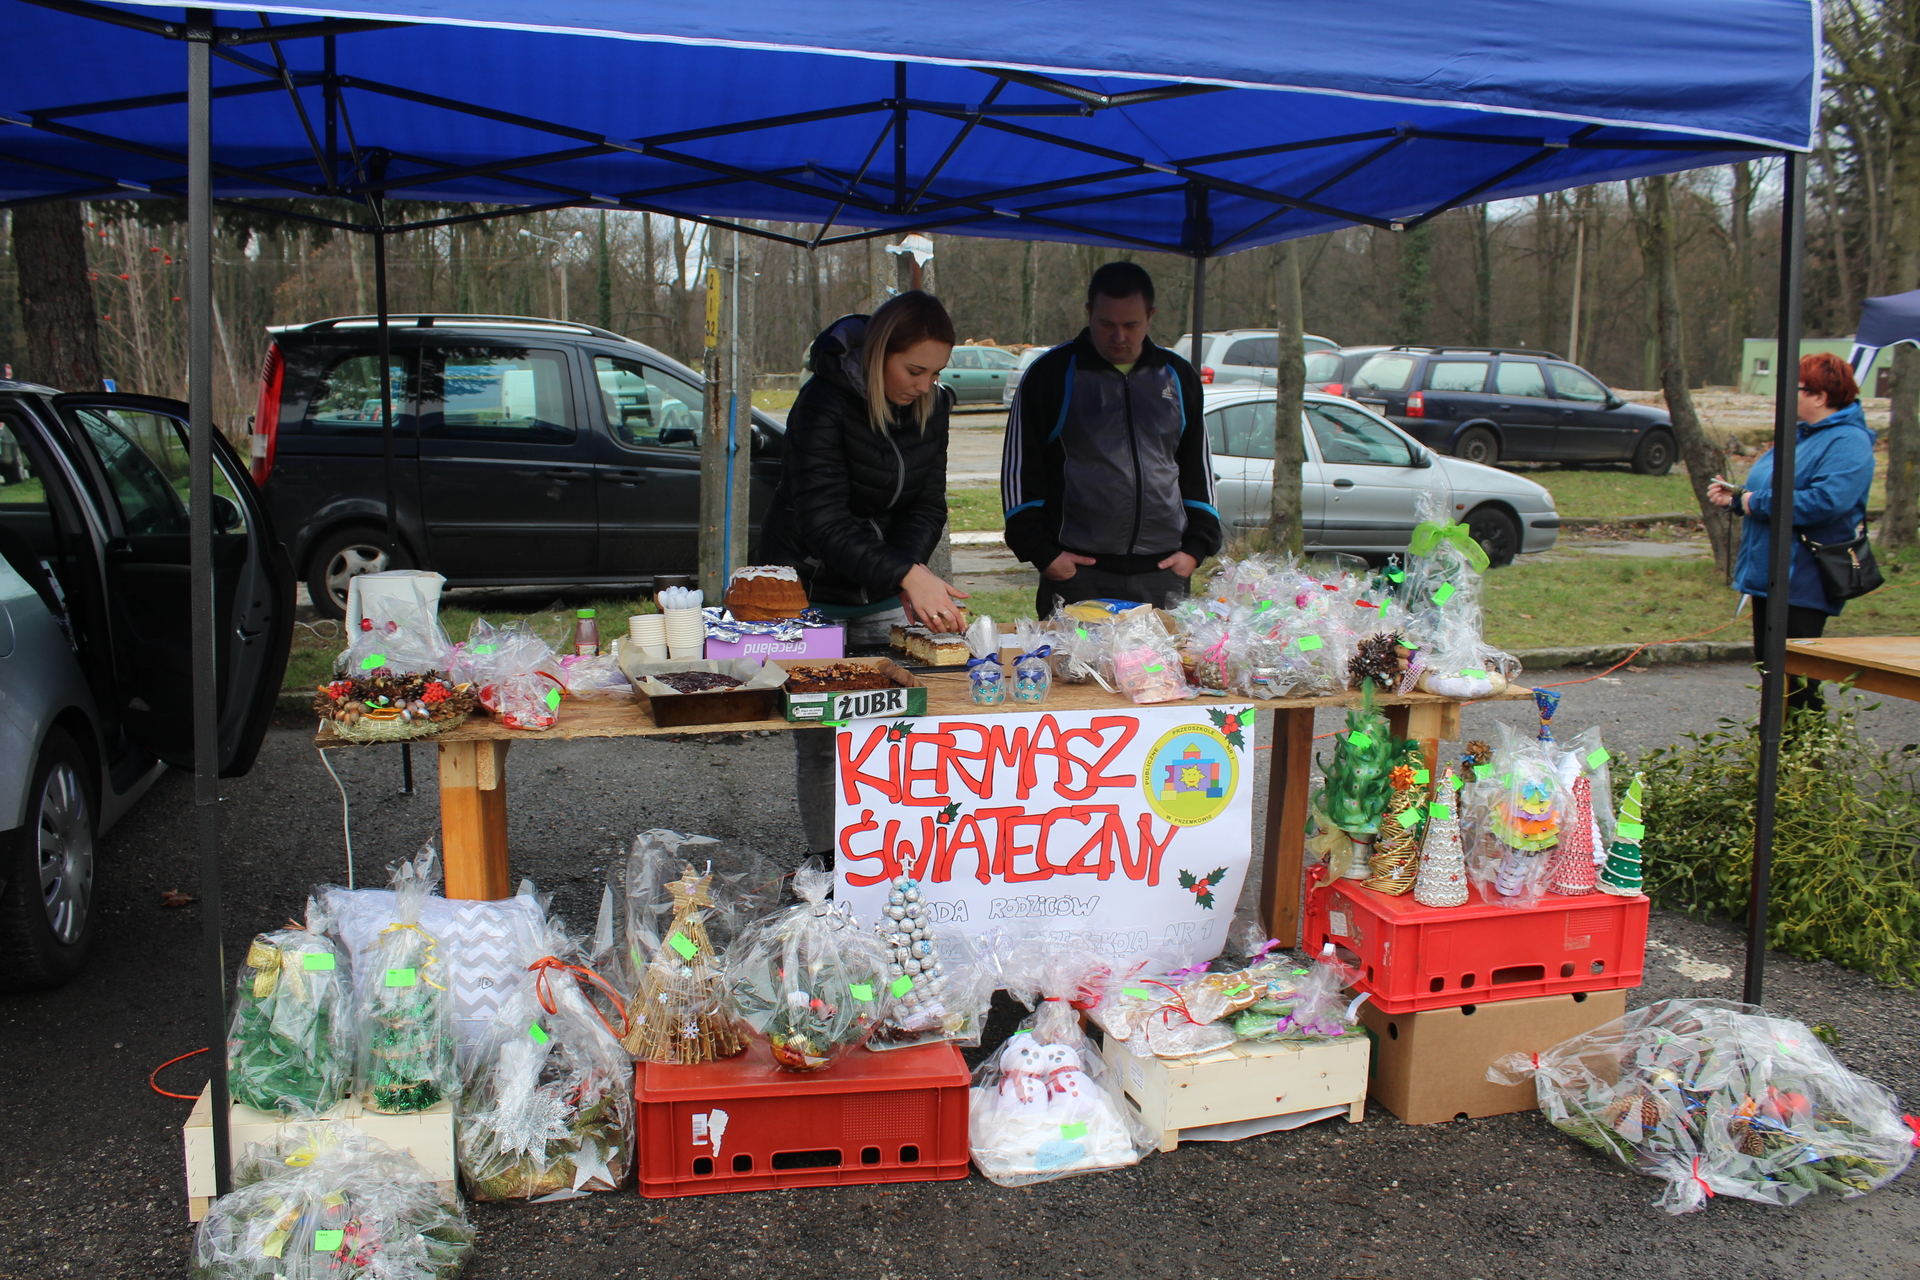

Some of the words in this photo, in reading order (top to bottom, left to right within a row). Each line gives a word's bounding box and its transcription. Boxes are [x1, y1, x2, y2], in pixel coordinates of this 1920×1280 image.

[743, 641, 807, 656] Graceland
[838, 689, 905, 720] ŻUBR
[1172, 725, 1215, 736] PRZEDSZKOLE
[1225, 745, 1234, 755] NR
[1144, 747, 1159, 786] PUBLICZNE
[1174, 814, 1213, 825] PRZEMKOWIE
[925, 899, 969, 923] ADA
[1162, 921, 1196, 946] NR
[1201, 918, 1215, 940] 1
